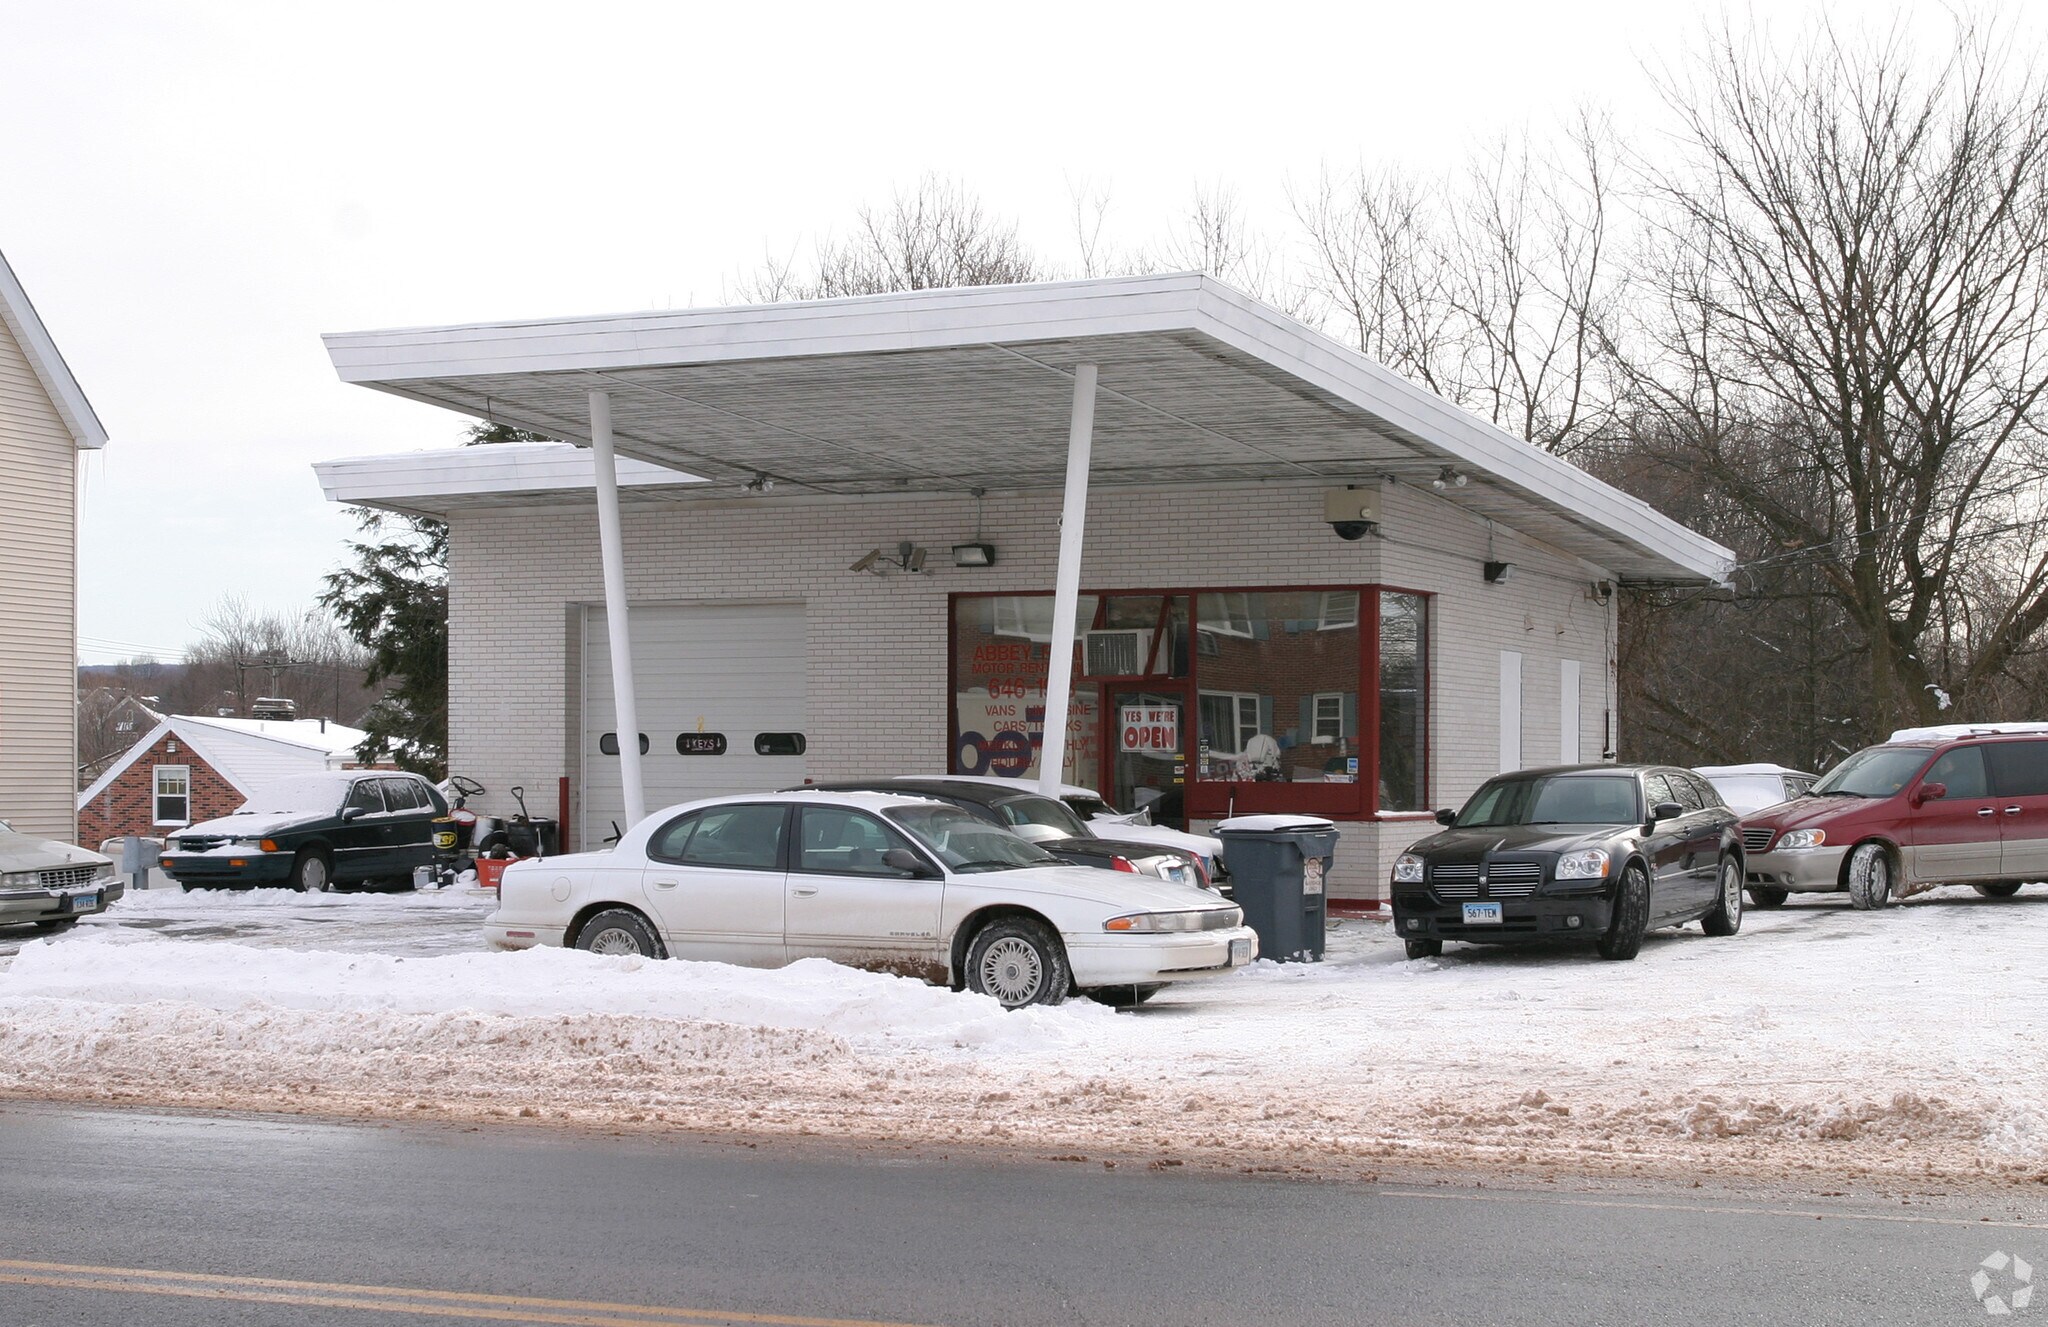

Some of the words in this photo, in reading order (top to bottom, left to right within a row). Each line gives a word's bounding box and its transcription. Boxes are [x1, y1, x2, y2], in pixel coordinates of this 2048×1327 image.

[973, 643, 1031, 661] ABBEY
[972, 662, 1014, 674] MOTOR
[985, 704, 1016, 716] VANS
[1124, 711, 1142, 722] YES
[1149, 711, 1174, 722] WE'RE
[1124, 726, 1175, 748] OPEN
[691, 738, 715, 749] KEYS
